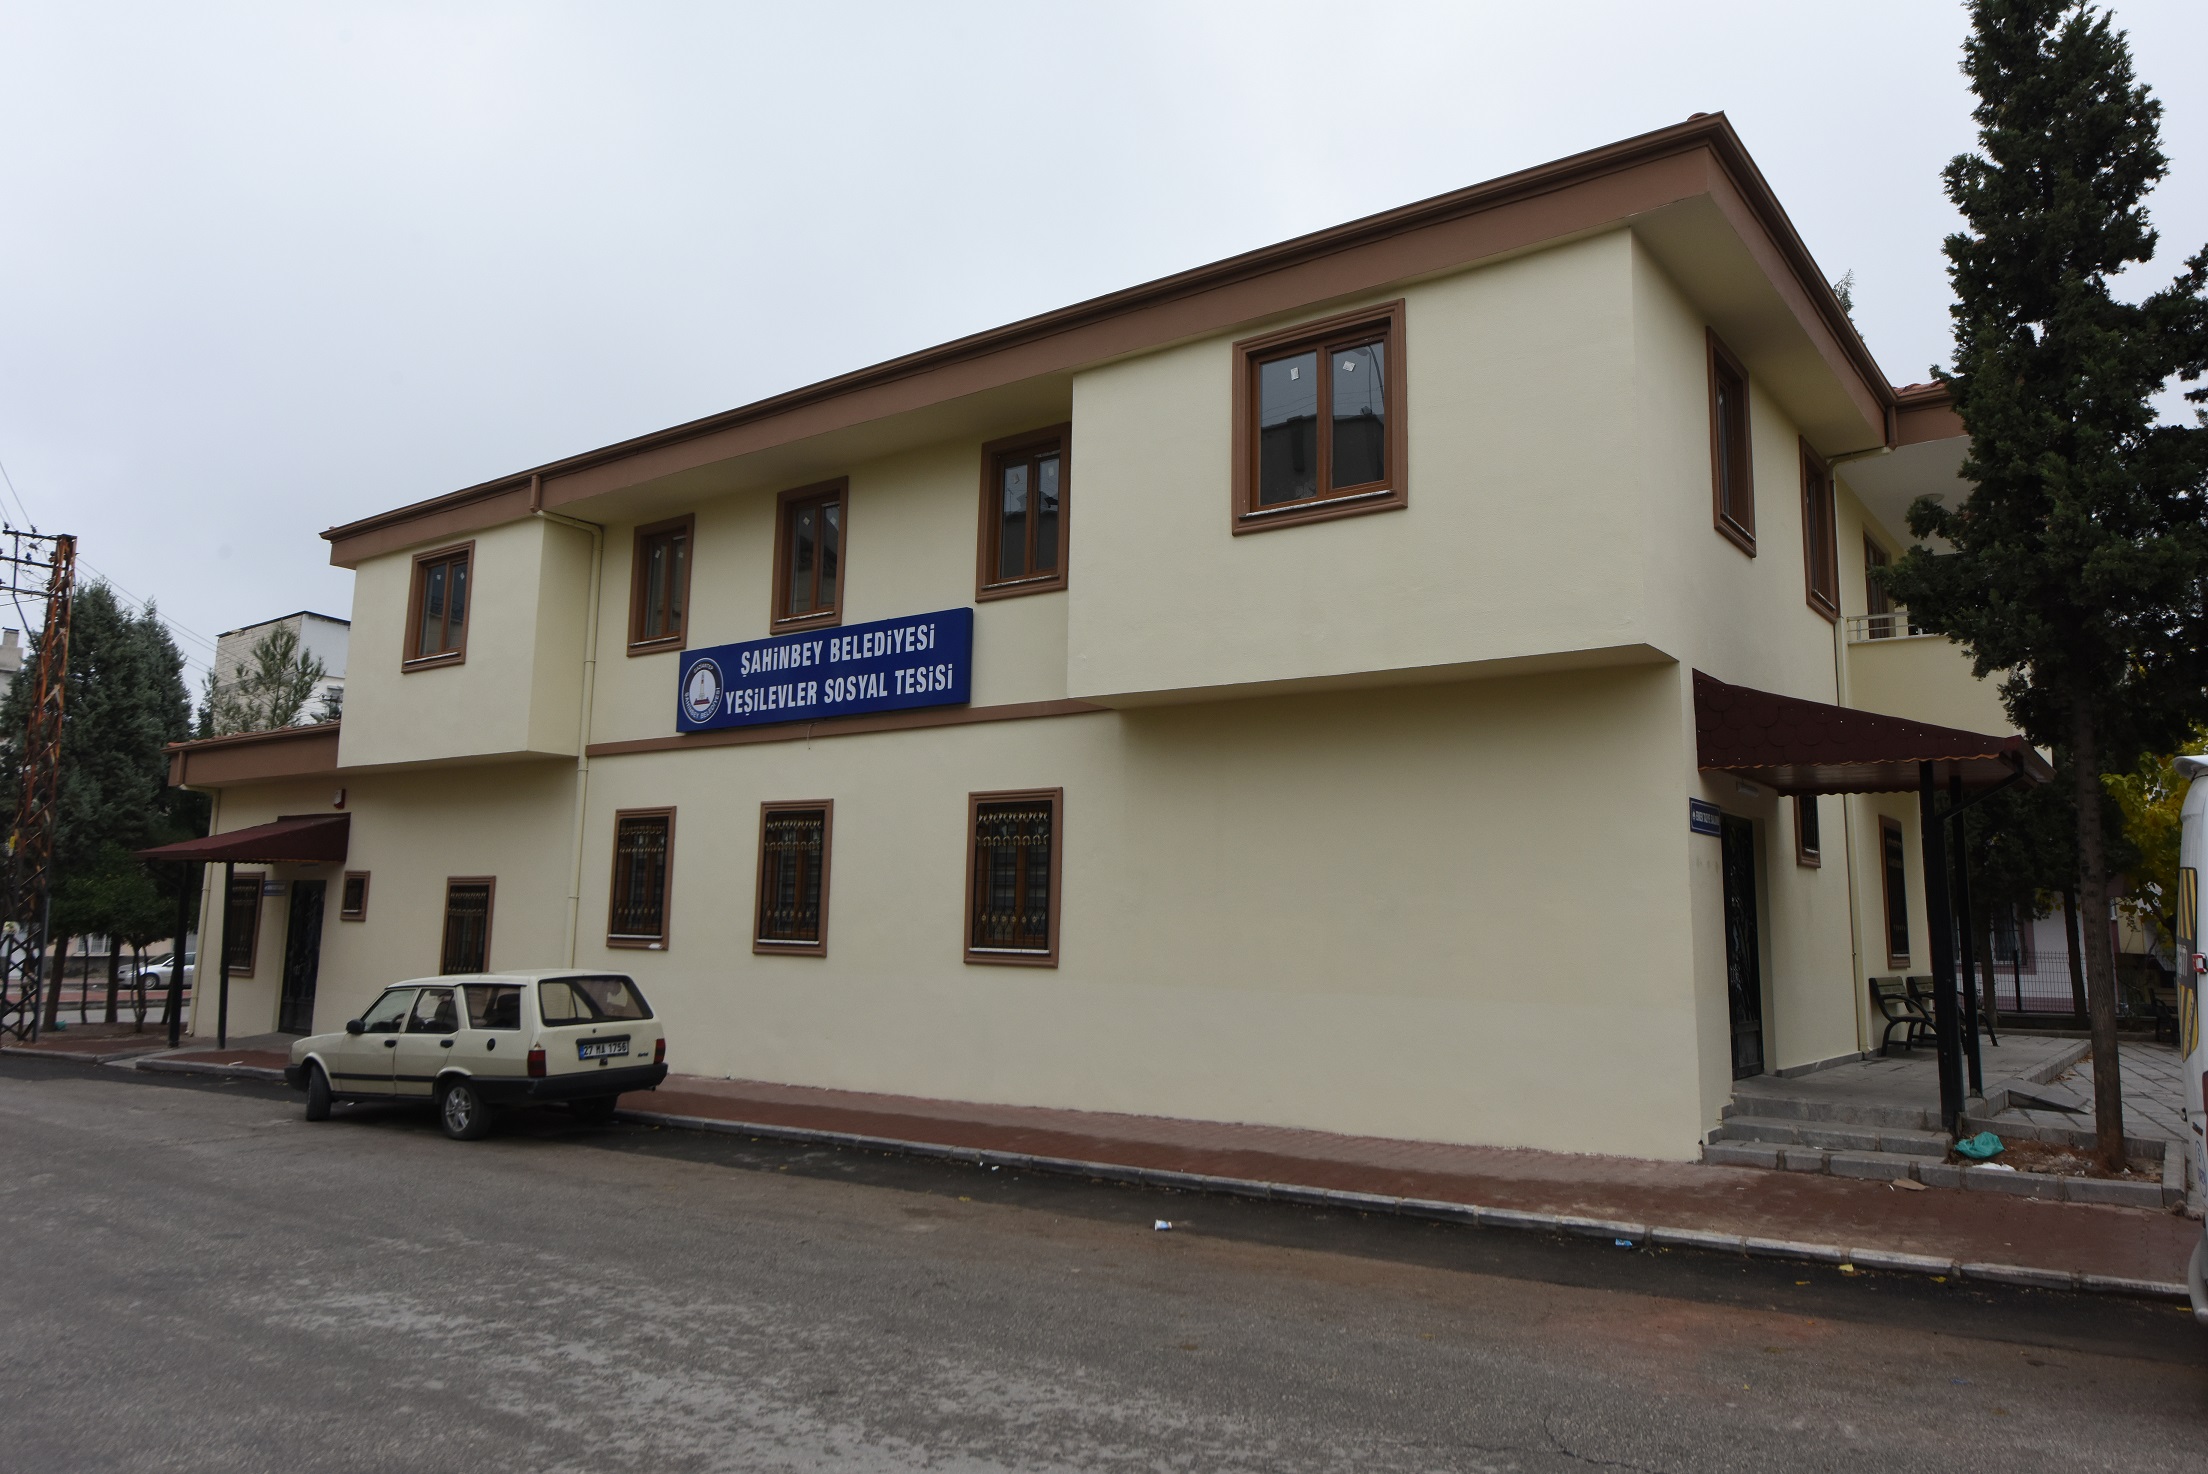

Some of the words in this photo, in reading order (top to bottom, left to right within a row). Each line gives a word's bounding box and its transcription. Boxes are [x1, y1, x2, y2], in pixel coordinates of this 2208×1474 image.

[740, 640, 823, 677] ŞAHİNBEY
[830, 623, 935, 663] BELEDİYESİ
[725, 681, 818, 716] YEŞİLEVLER
[824, 672, 888, 704] SOSYAL
[895, 663, 953, 695] TESİSİ
[583, 1045, 593, 1056] 27
